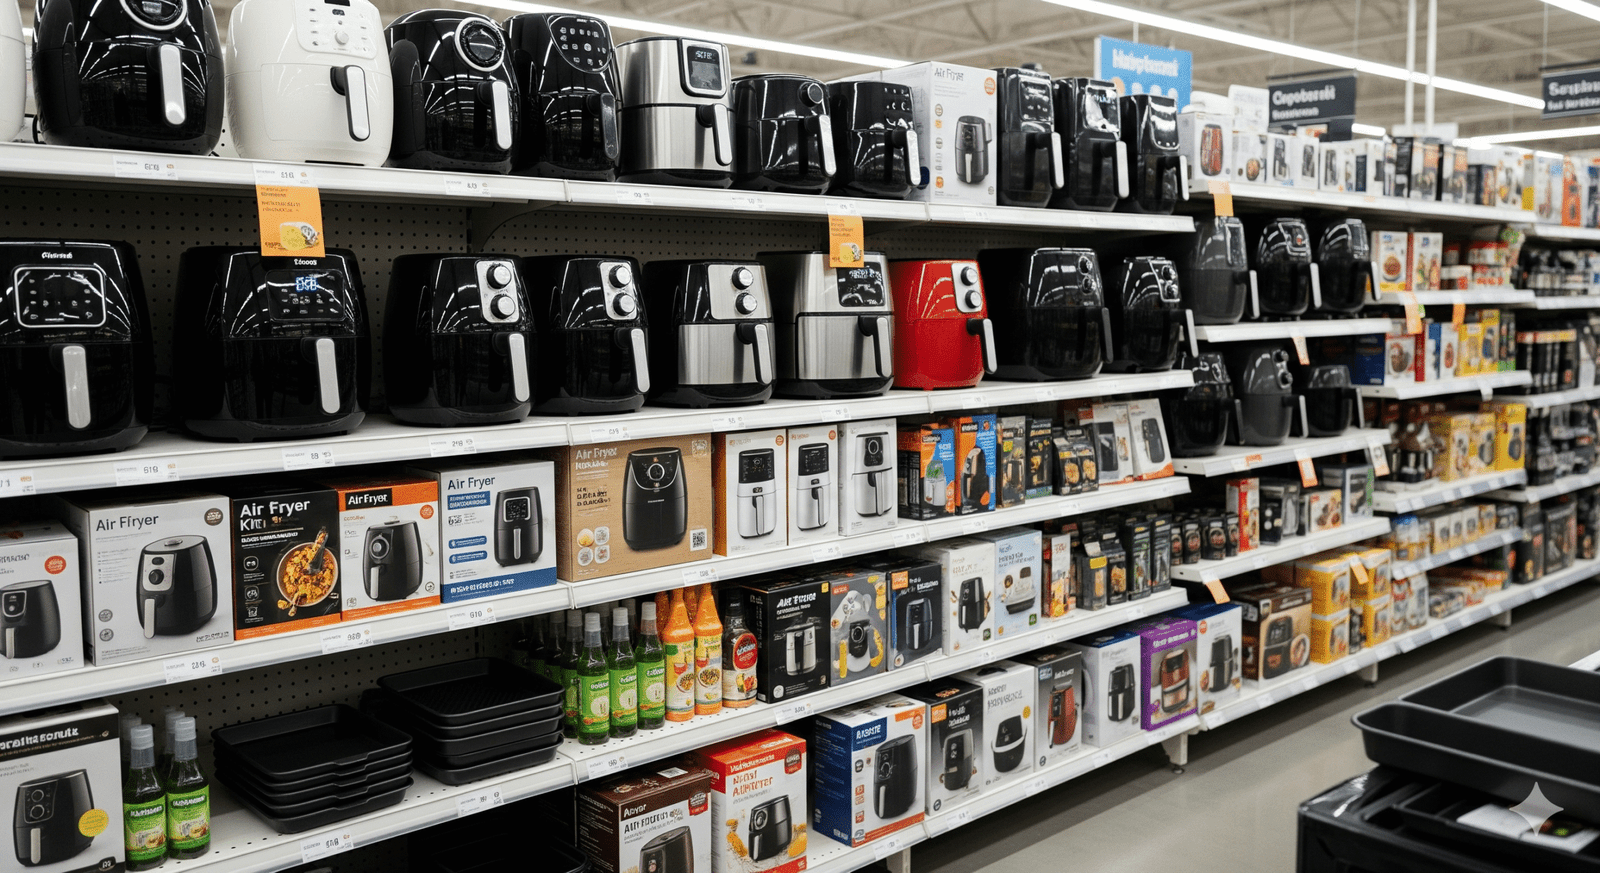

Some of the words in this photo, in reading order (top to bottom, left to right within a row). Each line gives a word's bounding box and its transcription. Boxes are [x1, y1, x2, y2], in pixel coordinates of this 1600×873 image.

[447, 479, 465, 491] Air
[467, 477, 496, 490] Fryer
[347, 494, 364, 506] Air
[363, 493, 388, 506] Fryer
[240, 502, 265, 518] Air
[268, 500, 311, 517] Fryer
[95, 518, 117, 532] Air
